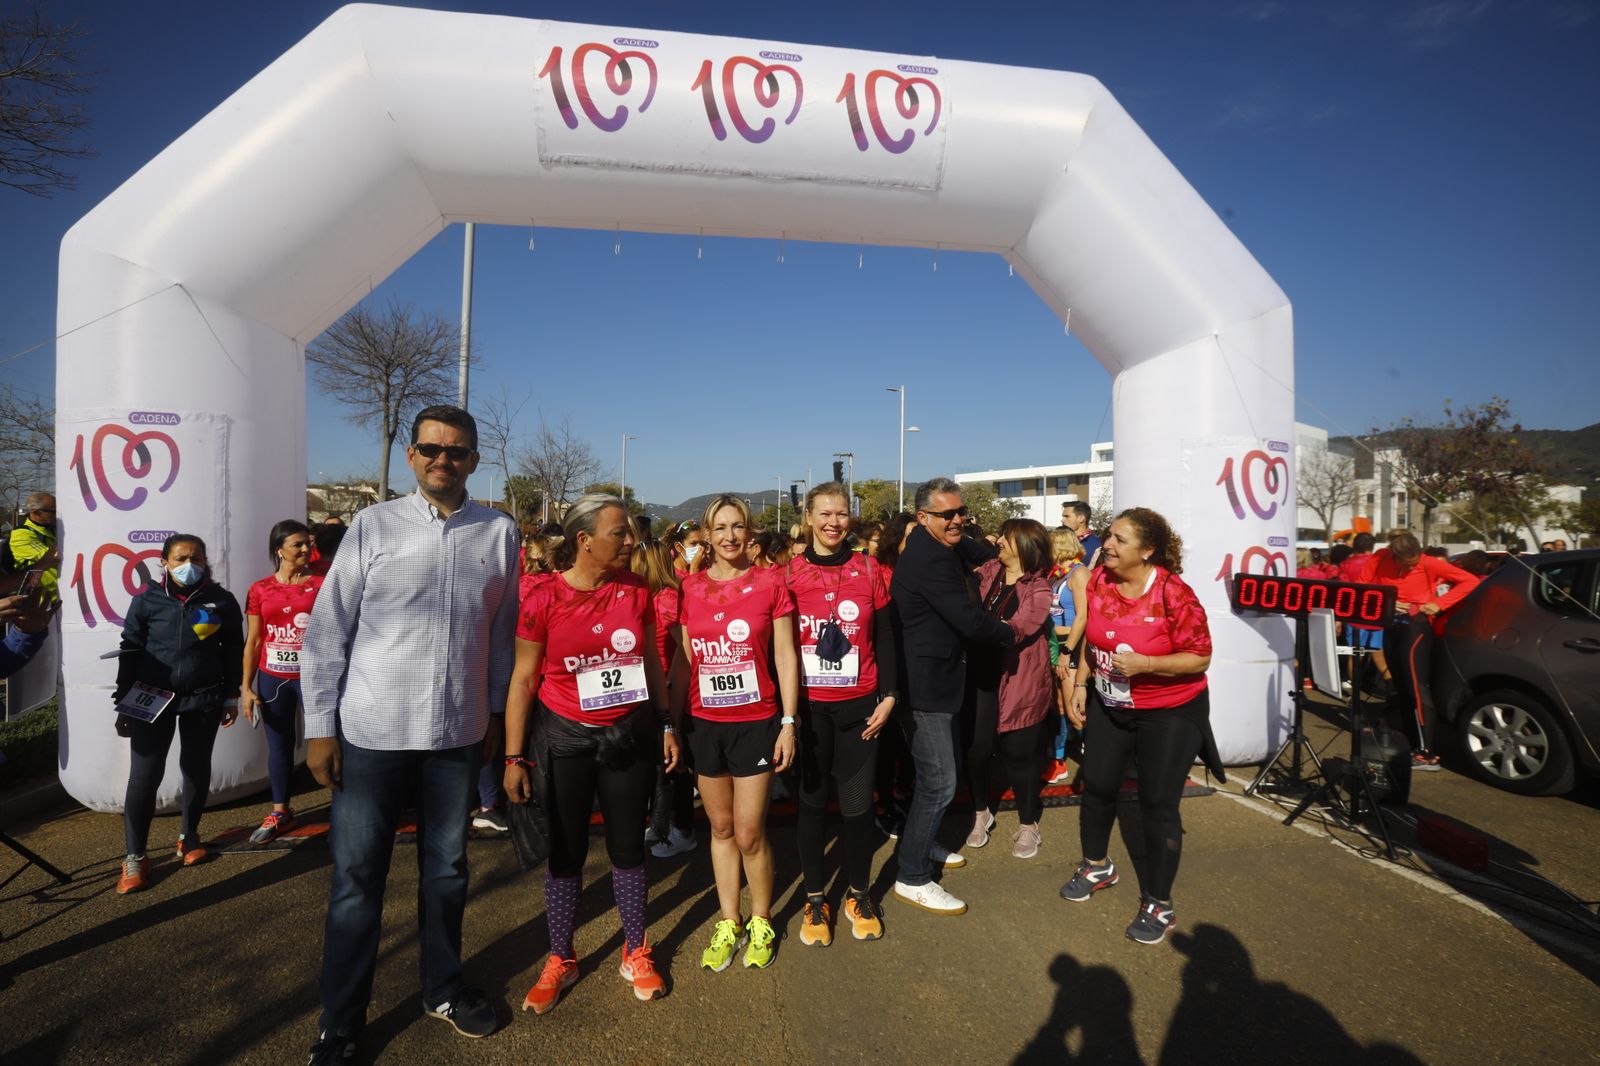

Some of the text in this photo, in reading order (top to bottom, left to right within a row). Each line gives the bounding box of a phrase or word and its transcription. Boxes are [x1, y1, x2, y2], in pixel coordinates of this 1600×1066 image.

[615, 38, 657, 48] CADENA
[761, 51, 801, 61] CADENA
[130, 413, 178, 424] CADENA
[266, 623, 297, 637] Pink
[799, 614, 842, 633] Pin
[691, 635, 732, 657] Pink
[276, 651, 299, 662] 523
[703, 655, 741, 664] RUNNING
[600, 669, 623, 688] 32
[710, 673, 744, 691] 1691
[1101, 679, 1112, 694] 61
